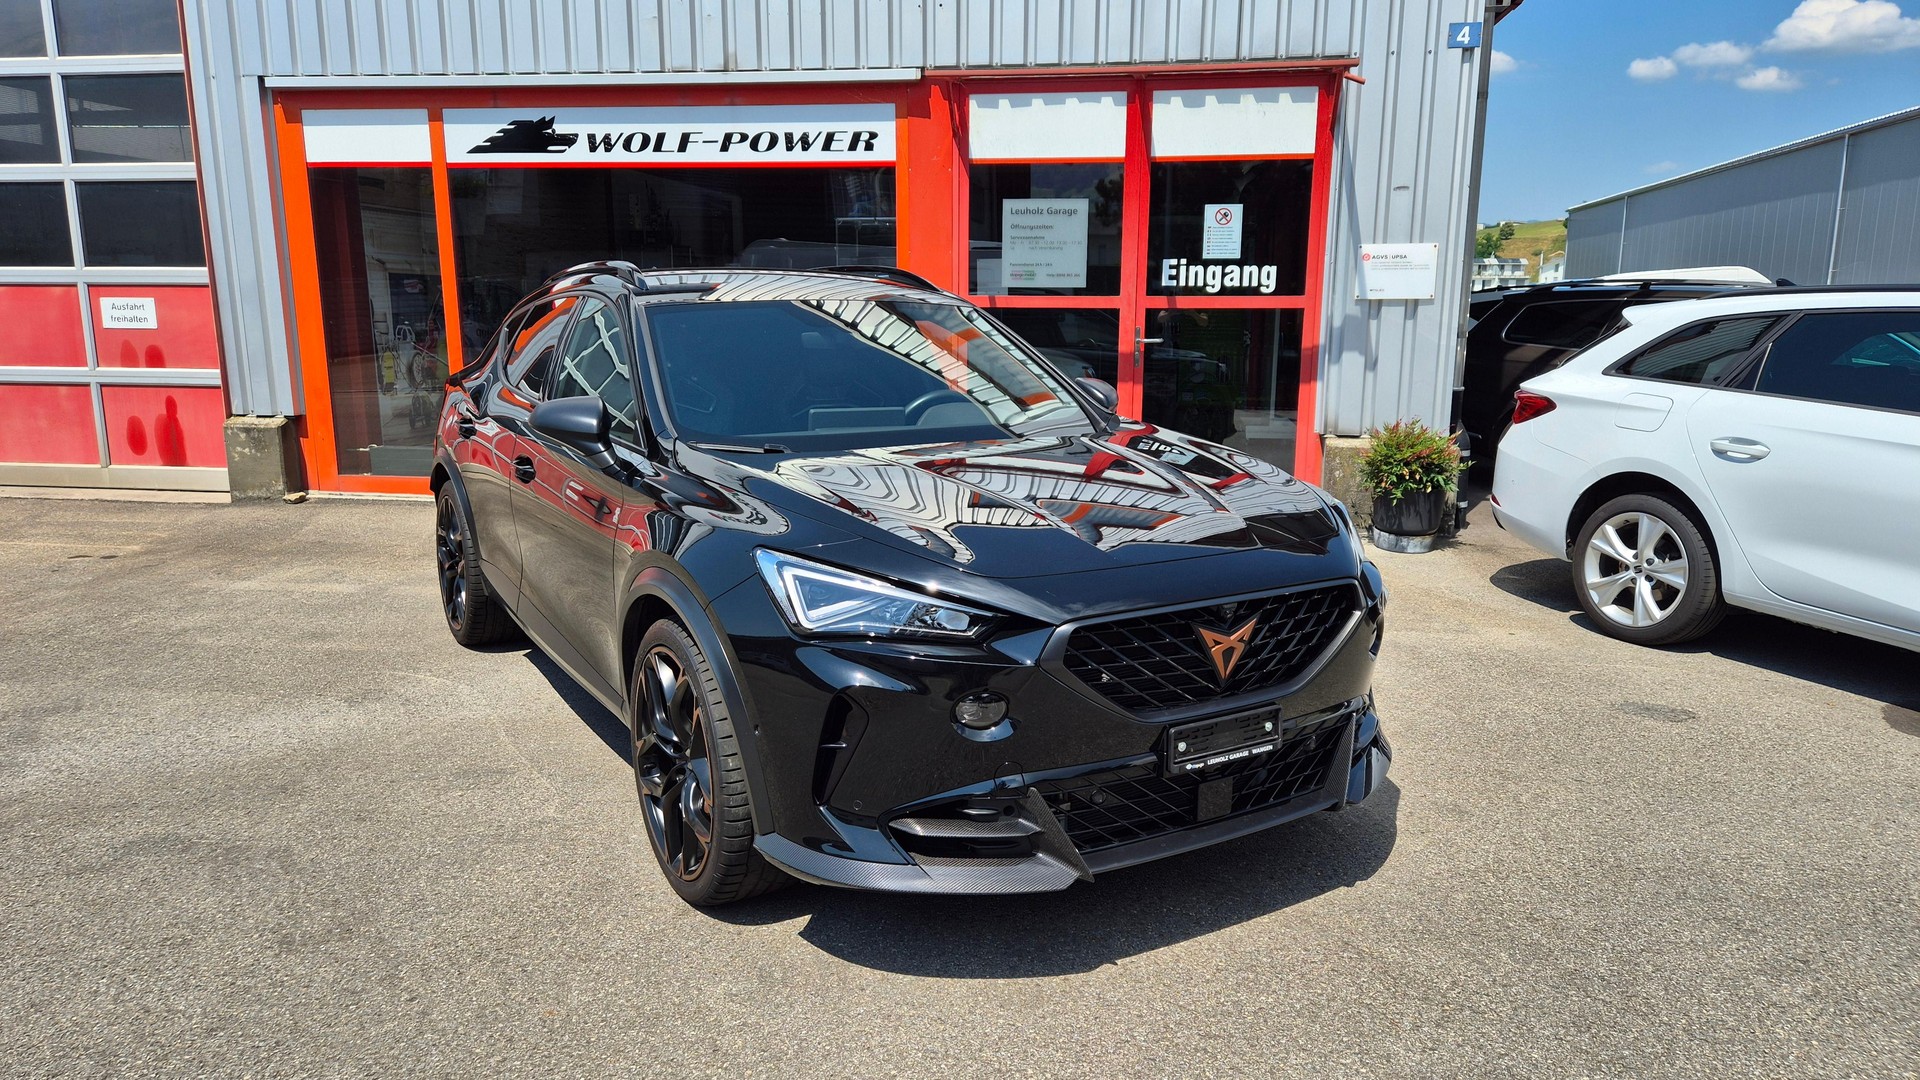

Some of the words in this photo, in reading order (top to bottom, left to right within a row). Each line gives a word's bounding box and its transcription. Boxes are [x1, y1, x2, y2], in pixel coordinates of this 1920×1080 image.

[1456, 25, 1470, 45] 4
[587, 130, 879, 153] WOLF-POWER
[1010, 206, 1044, 215] Leuholz
[1047, 206, 1078, 217] Garage
[1161, 258, 1278, 294] Eingang
[111, 302, 145, 311] Ausfahrt
[110, 315, 148, 323] freihalten
[1207, 755, 1229, 765] LEUHOLZ
[1229, 750, 1249, 760] GARAGE
[1252, 745, 1274, 755] WANGEN
